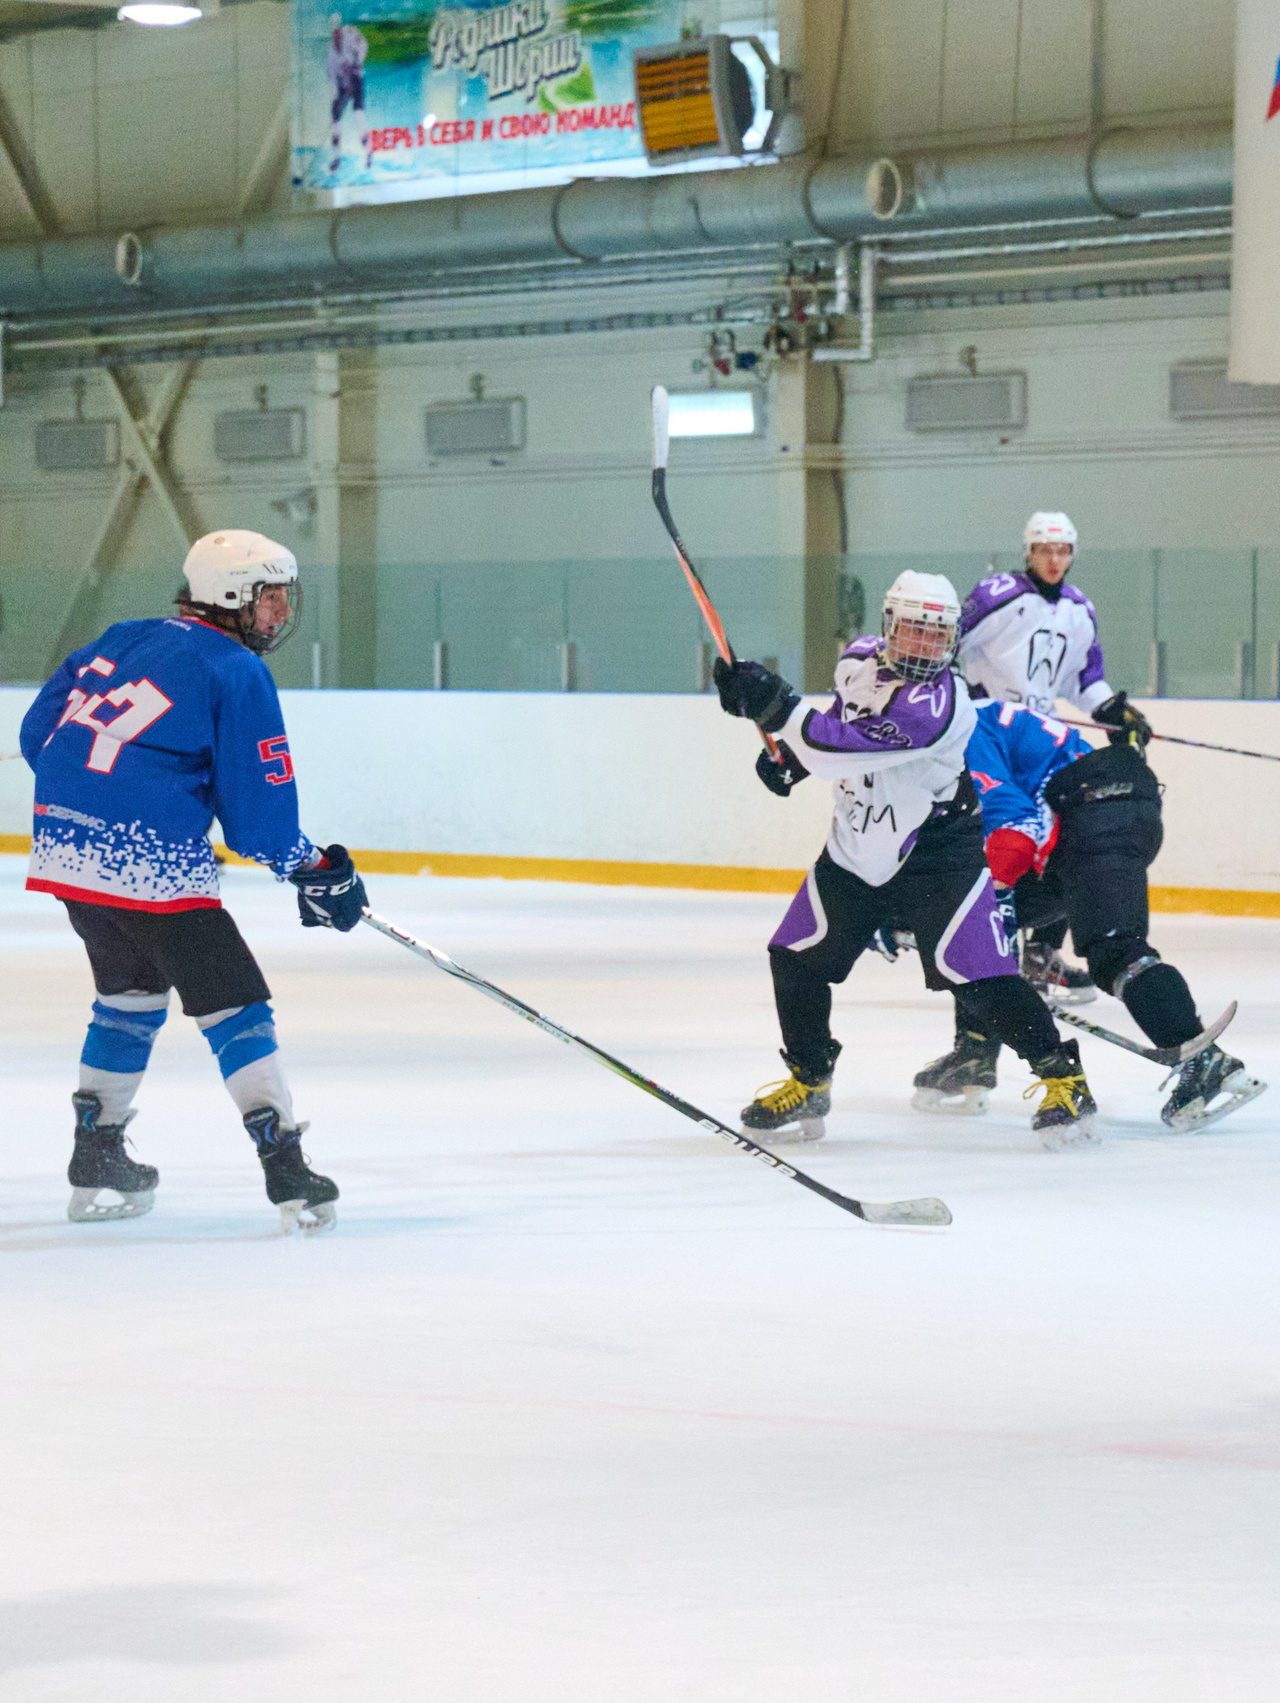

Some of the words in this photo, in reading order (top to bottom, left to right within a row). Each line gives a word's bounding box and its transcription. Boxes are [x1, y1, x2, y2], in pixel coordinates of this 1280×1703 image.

[430, 119, 475, 146] СЕБЯ
[481, 118, 494, 142] И
[500, 112, 549, 140] СВОЮ
